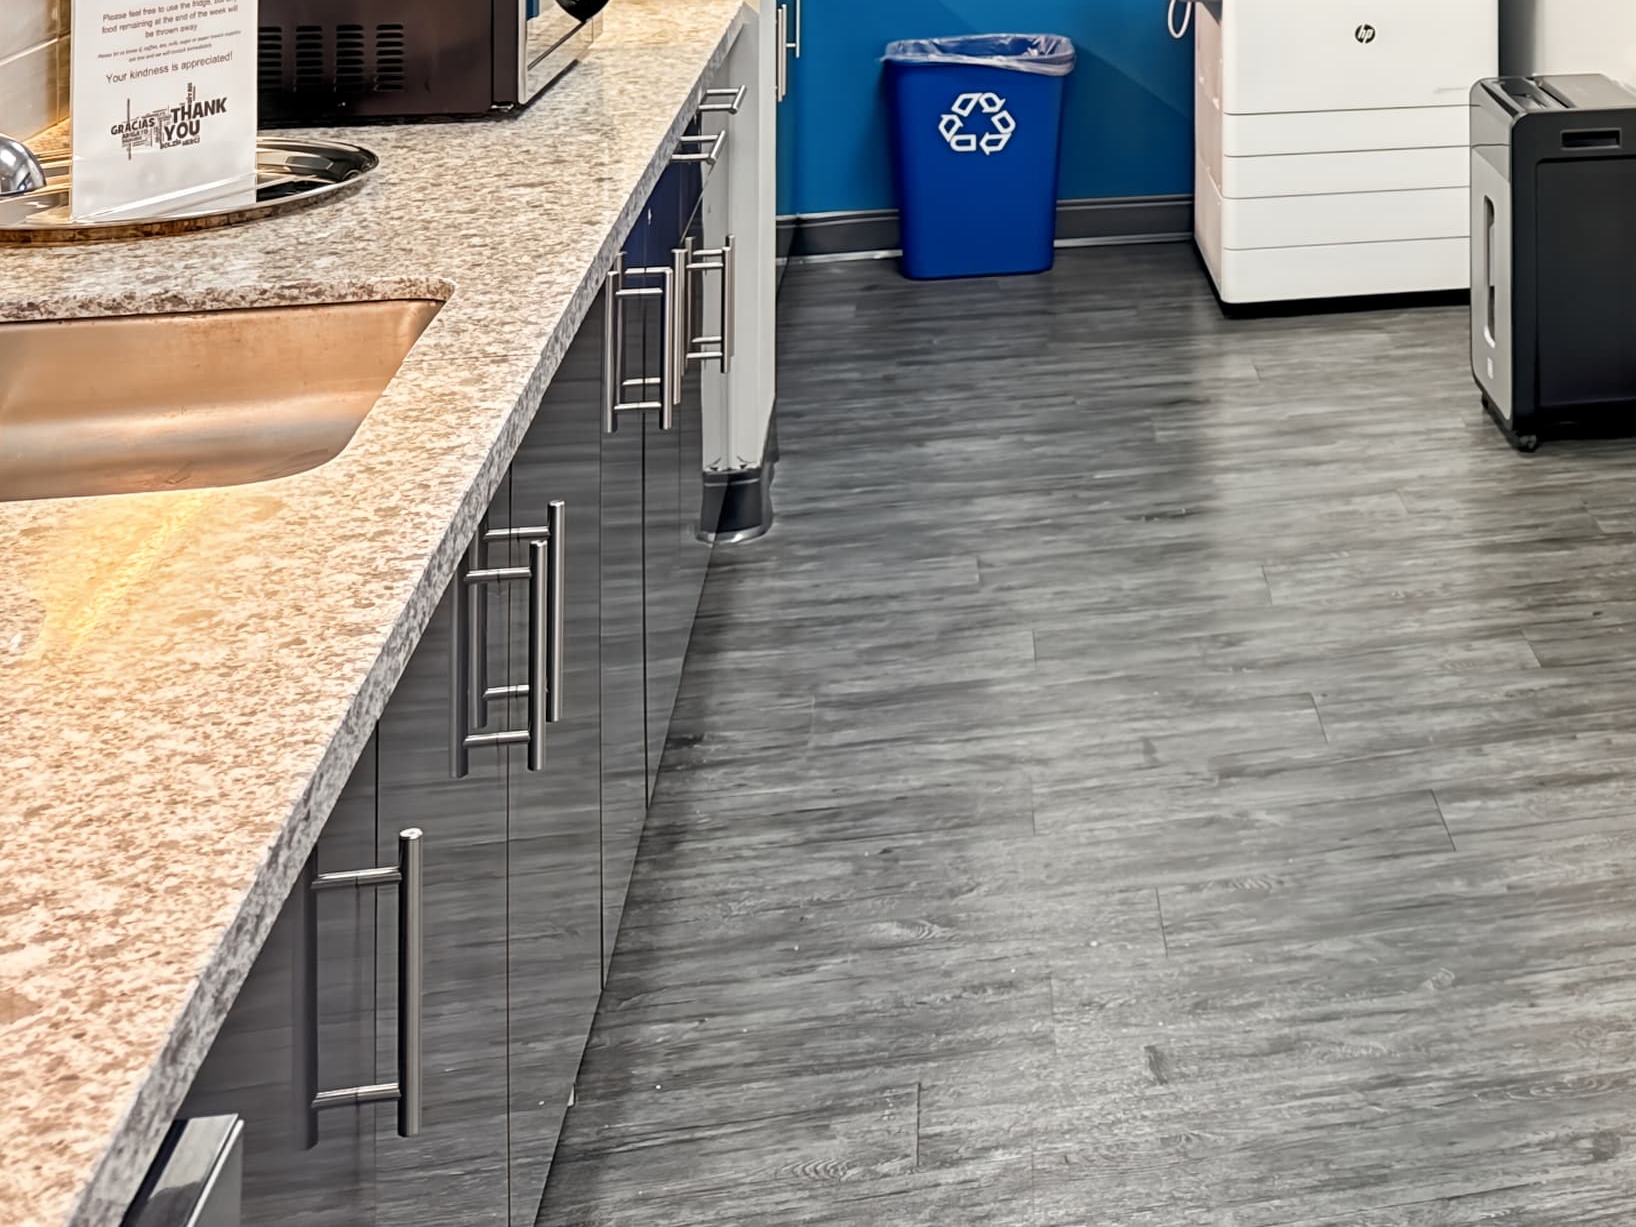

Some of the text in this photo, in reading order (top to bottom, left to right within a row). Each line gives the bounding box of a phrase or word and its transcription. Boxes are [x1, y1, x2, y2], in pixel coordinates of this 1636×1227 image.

[102, 25, 117, 34] food
[119, 20, 153, 32] remaining
[175, 14, 188, 22] end
[197, 10, 208, 18] the
[209, 7, 226, 16] week
[103, 12, 127, 22] Please
[129, 9, 141, 18] feel
[143, 7, 156, 15] free
[166, 4, 178, 12] use
[180, 2, 190, 10] the
[145, 24, 198, 39] be thrown away
[1355, 24, 1375, 44] hp
[106, 73, 127, 84] Your
[130, 64, 169, 79] kindness
[171, 63, 179, 71] is
[181, 51, 233, 70] appreciated!
[170, 96, 228, 124] THANK
[110, 118, 155, 135] GRACIAS
[164, 120, 200, 141] YOU
